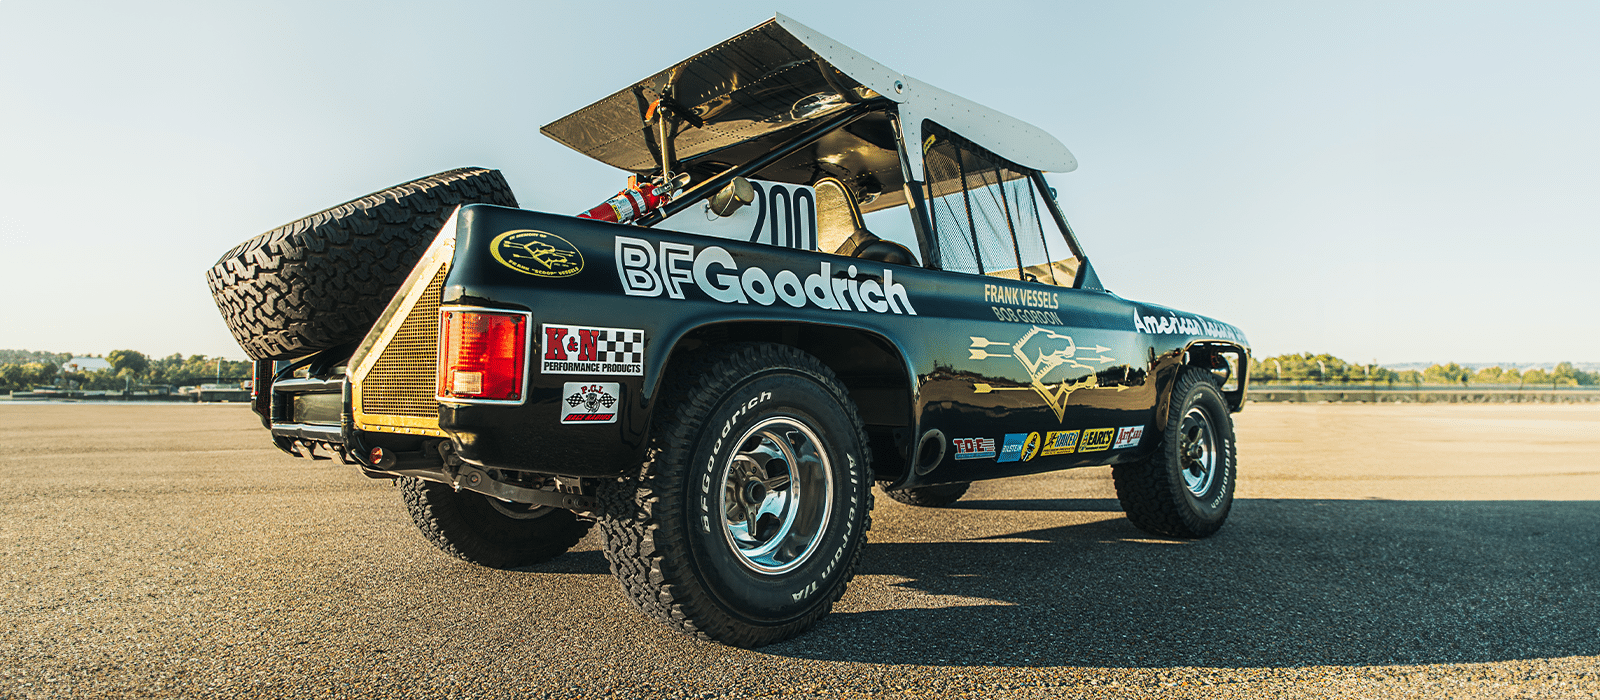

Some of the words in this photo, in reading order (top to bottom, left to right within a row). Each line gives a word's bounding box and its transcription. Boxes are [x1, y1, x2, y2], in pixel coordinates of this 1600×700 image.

[614, 235, 918, 316] BFGoodrich
[984, 283, 1019, 306] FRANK
[1019, 288, 1059, 309] VESSELS
[991, 306, 1019, 322] BOB
[1016, 309, 1064, 325] GORDON
[1133, 307, 1203, 335] American
[545, 327, 600, 361] K&N
[543, 362, 600, 372] PERFORMANCE
[602, 363, 641, 373] PRODUCTS
[1086, 430, 1114, 446] EARL'S
[700, 390, 772, 534] BFGoodrich
[821, 452, 859, 580] All-Terrain
[792, 579, 820, 604] T/A
